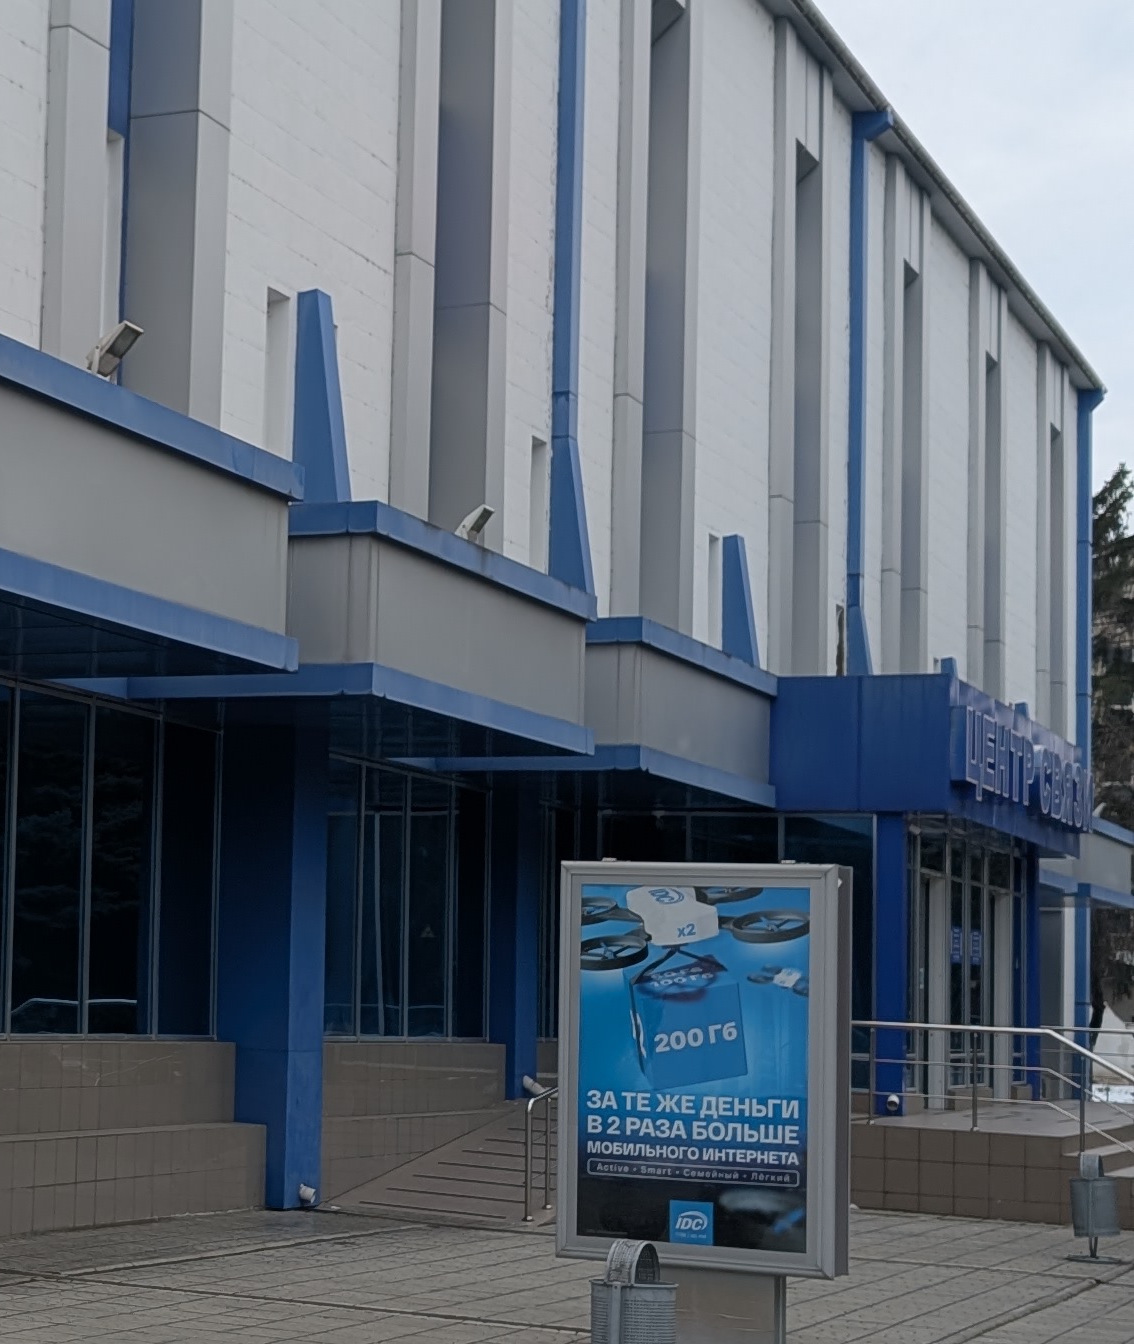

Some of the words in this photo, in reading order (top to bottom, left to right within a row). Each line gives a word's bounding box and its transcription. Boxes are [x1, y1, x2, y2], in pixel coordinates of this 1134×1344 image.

[966, 706, 1035, 806] ЦЕНТР
[1040, 748, 1095, 834] СВЯЗИ
[653, 1027, 705, 1053] 200
[708, 1021, 738, 1044] Гб
[586, 1089, 618, 1110] ЗА
[621, 1091, 651, 1112] ТЕ
[655, 1093, 696, 1114] ЖЕ
[699, 1096, 800, 1119] ДЕНЬГИ
[587, 1114, 603, 1134] В
[606, 1115, 621, 1135] 2
[625, 1116, 688, 1139] РАЗА
[692, 1120, 800, 1145] БОЛЬШЕ
[587, 1140, 700, 1161] МОБИЛЬНОГО
[702, 1147, 800, 1166] ИНТЕРНЕТА
[596, 1162, 630, 1173] Active
[640, 1165, 672, 1176] Smart
[675, 1215, 705, 1231] IDC
